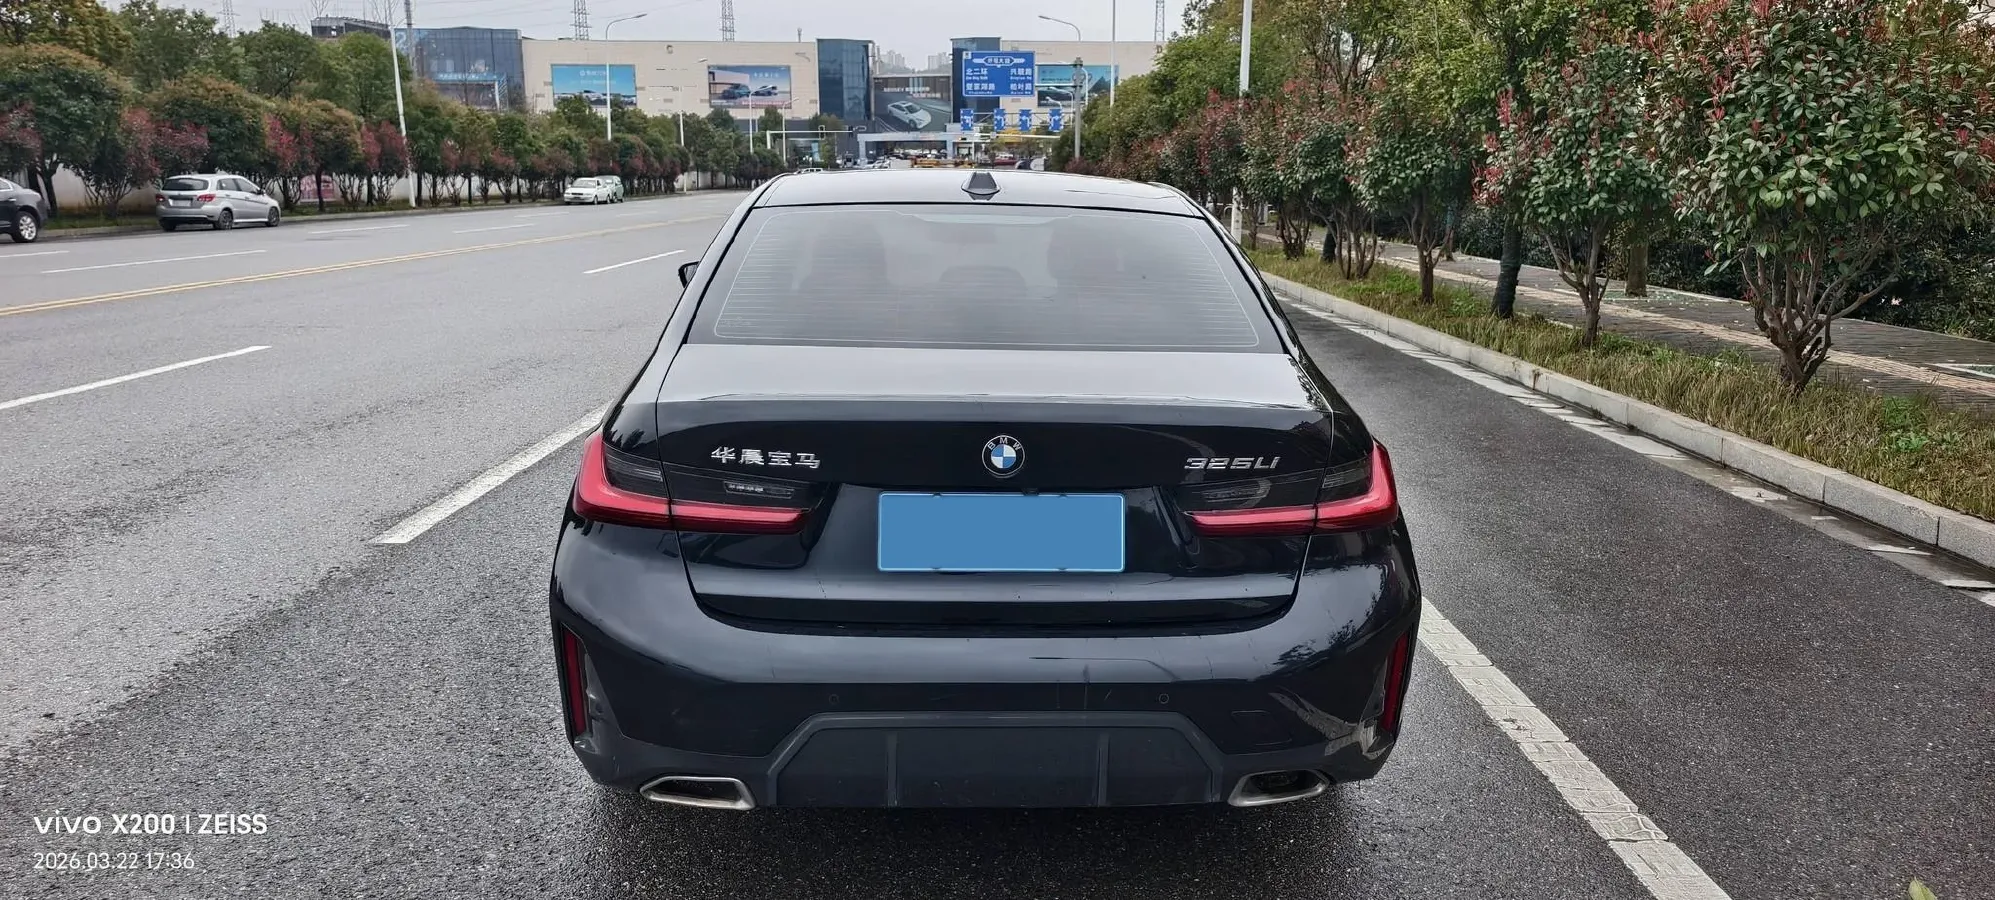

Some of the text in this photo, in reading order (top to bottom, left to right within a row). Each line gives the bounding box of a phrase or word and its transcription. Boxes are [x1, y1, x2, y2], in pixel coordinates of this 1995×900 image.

[987, 437, 1021, 451] BMW
[710, 446, 821, 469] 华晨宝马
